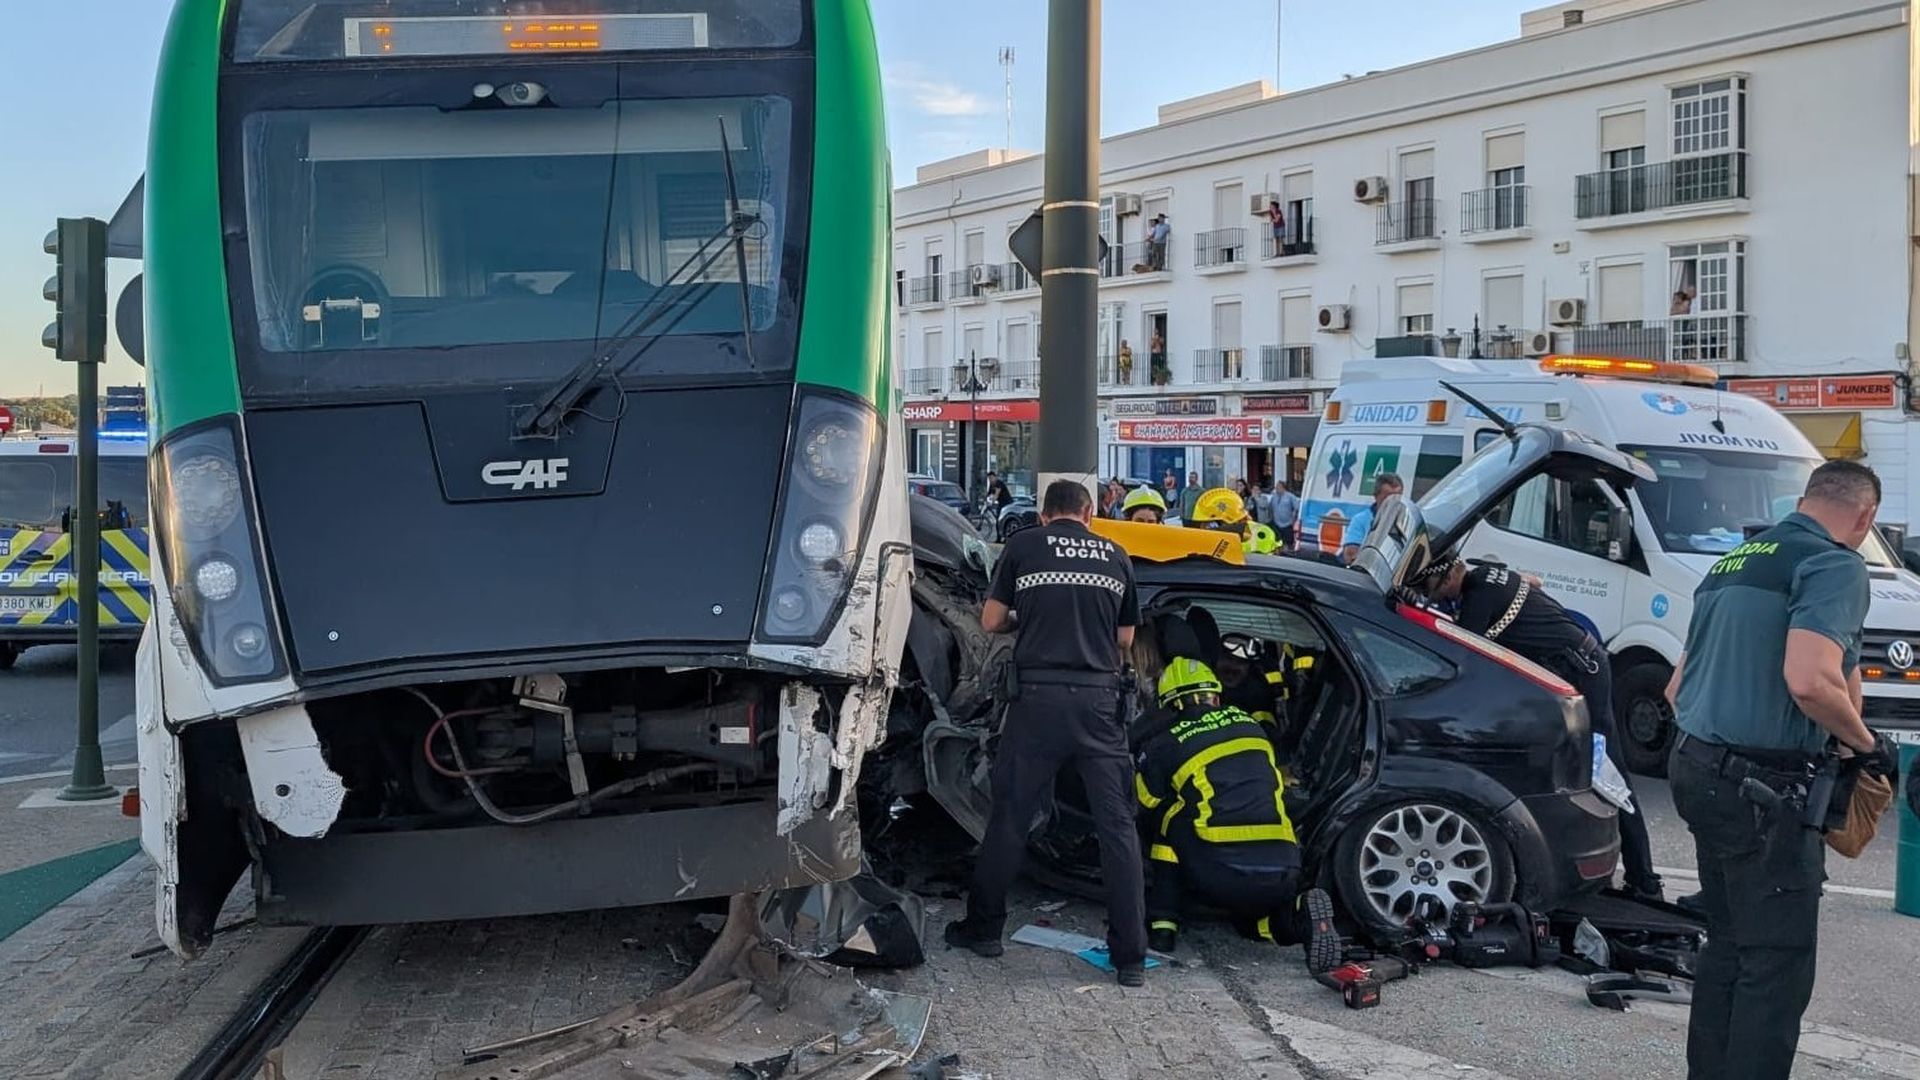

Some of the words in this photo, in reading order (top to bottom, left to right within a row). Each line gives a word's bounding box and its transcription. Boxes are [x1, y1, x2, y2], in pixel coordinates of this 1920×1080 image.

[1837, 384, 1890, 394] JUNKERS
[904, 407, 942, 419] SHARP
[1115, 402, 1155, 413] SEGURIDAD
[1157, 400, 1216, 414] INTERACTIVA
[1354, 404, 1418, 422] UNIDAD
[1235, 424, 1243, 438] 2
[482, 458, 568, 490] CAF
[1047, 535, 1115, 552] POLICIA
[1055, 546, 1110, 562] LOCAL
[1711, 557, 1747, 574] CIVIL
[1546, 572, 1577, 584] Andaluz
[1577, 577, 1587, 586] de
[1588, 577, 1608, 590] Salud
[1565, 584, 1577, 592] DE
[1580, 586, 1607, 597] SALUD
[29, 598, 52, 609] KMJ
